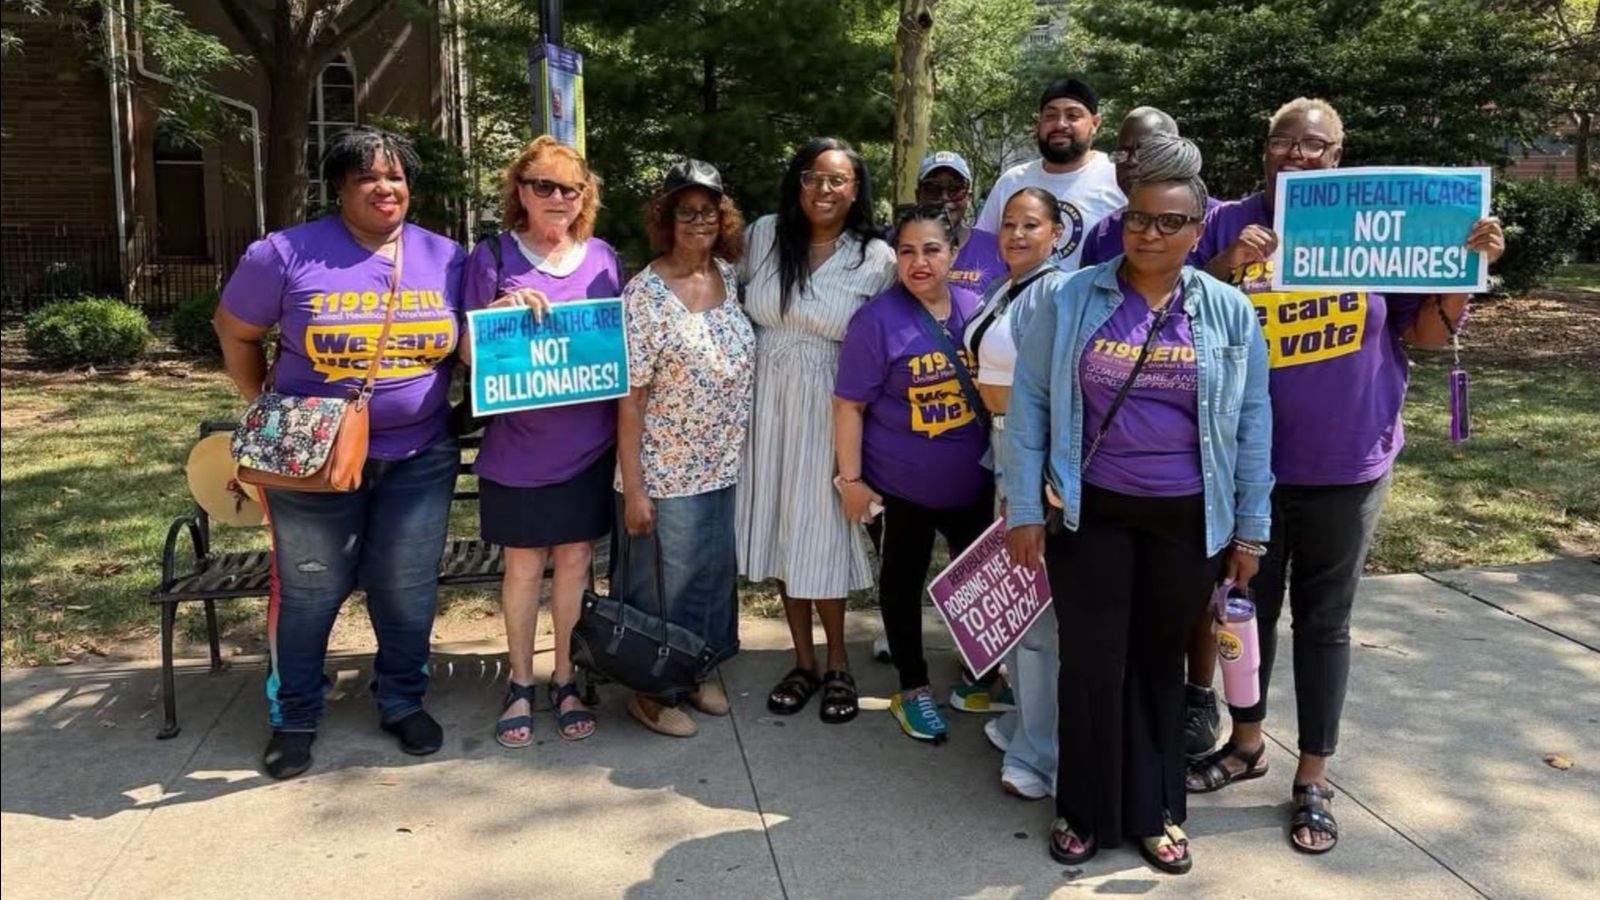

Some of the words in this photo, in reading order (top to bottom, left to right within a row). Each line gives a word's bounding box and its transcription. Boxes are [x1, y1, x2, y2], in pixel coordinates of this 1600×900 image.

[1288, 182, 1341, 208] FUND
[1346, 178, 1478, 206] HEALTHCARE
[1354, 210, 1406, 242] NOT
[1293, 246, 1467, 278] BILLIONAIRES!
[1278, 291, 1359, 324] care
[312, 333, 368, 354] We
[477, 316, 518, 344] FUND
[1280, 322, 1358, 358] vote
[530, 337, 570, 367] NOT
[484, 361, 620, 404] BILLIONAIRES!
[944, 571, 990, 620] ROBBING
[982, 553, 1011, 585] THE
[959, 607, 986, 638] TO
[982, 575, 1020, 618] GIVE
[975, 618, 1011, 657] THE
[1005, 583, 1040, 634] RICH!
